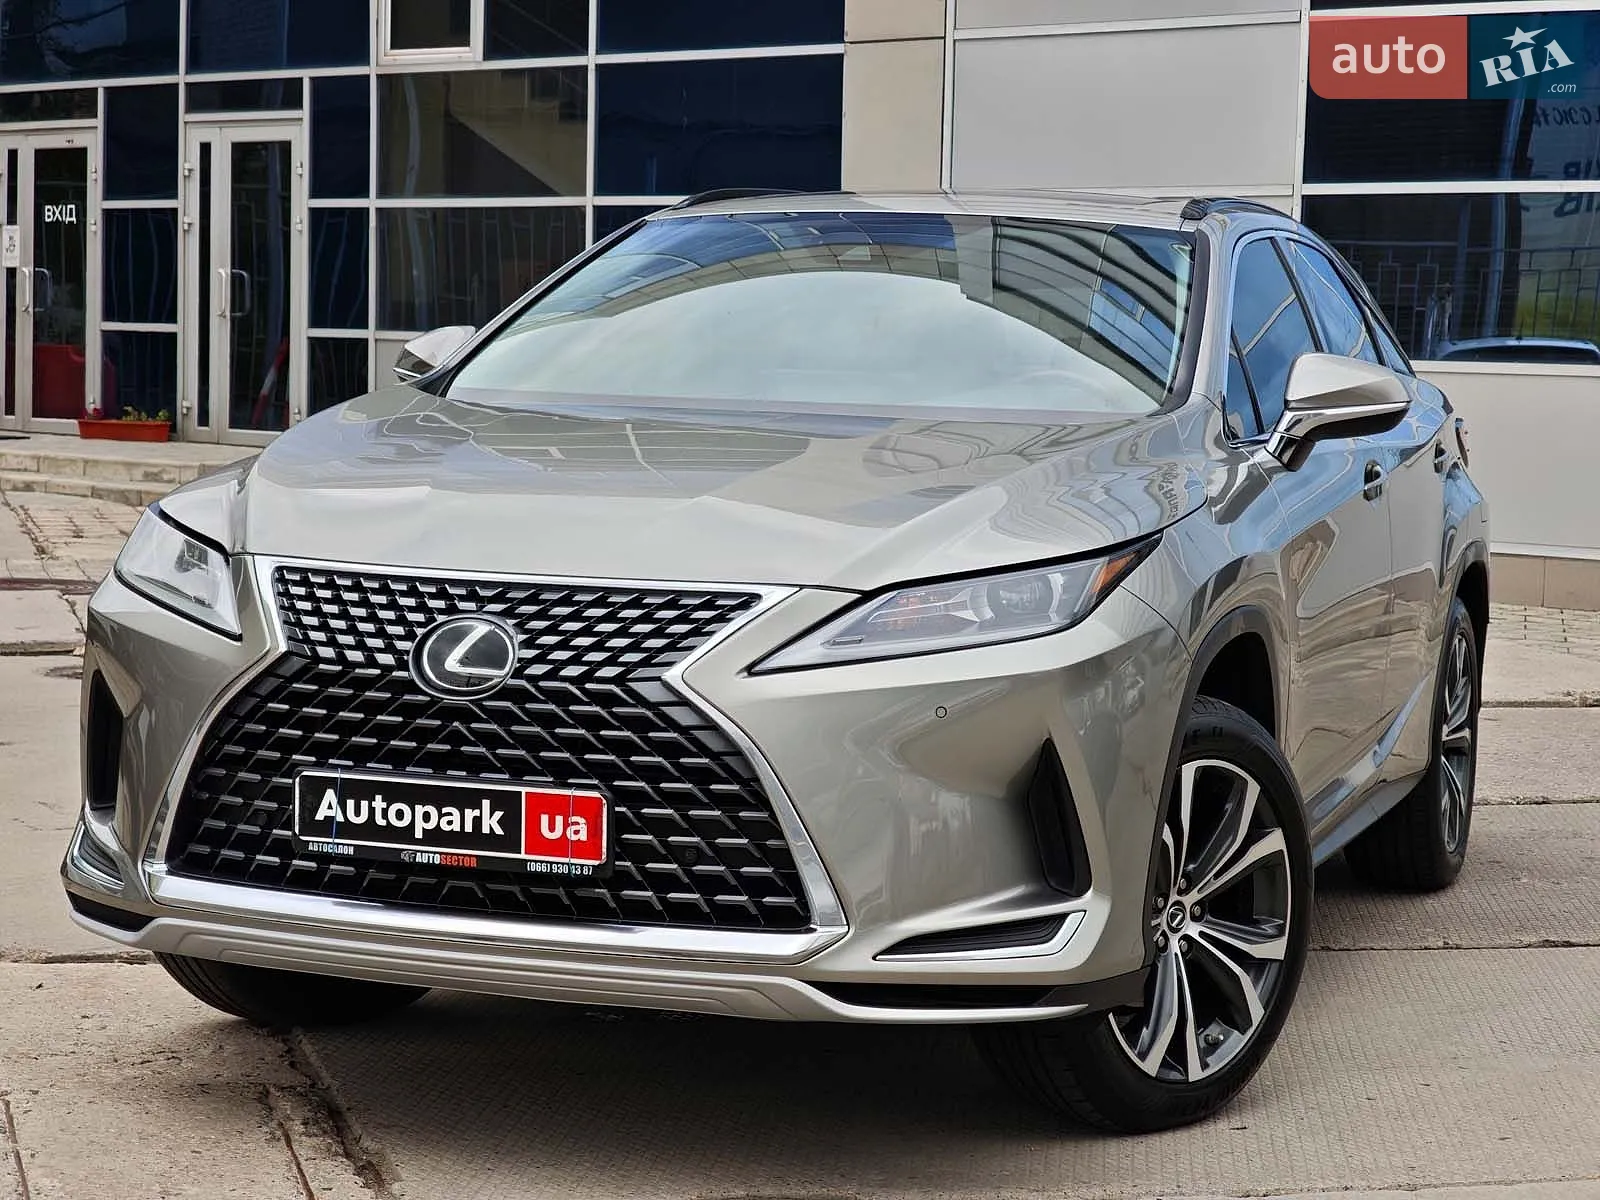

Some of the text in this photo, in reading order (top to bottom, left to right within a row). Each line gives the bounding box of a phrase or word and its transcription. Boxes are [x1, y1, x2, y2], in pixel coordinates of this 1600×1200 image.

[44, 204, 77, 224] ВХІД
[314, 788, 589, 842] Autopark ua
[308, 841, 354, 855] АВТОСАЛОН
[415, 853, 477, 868] AUTOSECTOR
[527, 861, 550, 873] (066)
[552, 863, 569, 874] 930
[583, 865, 593, 876] 87
